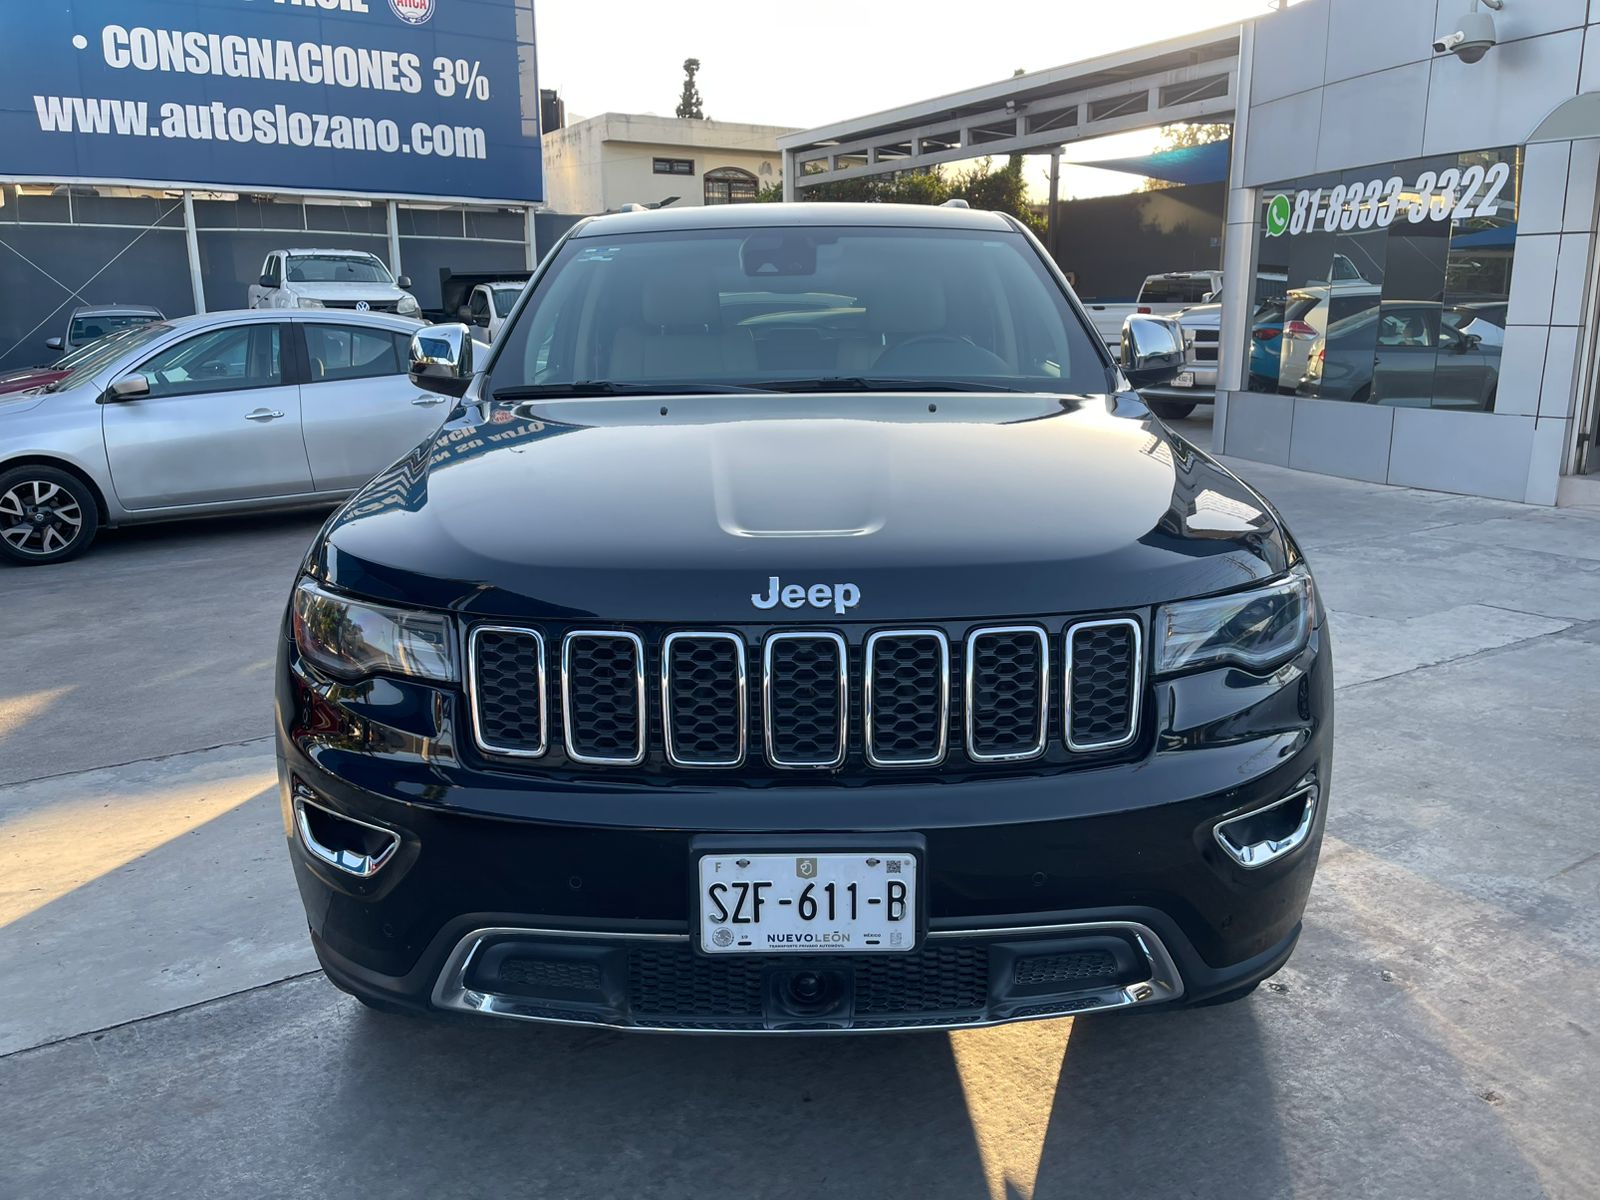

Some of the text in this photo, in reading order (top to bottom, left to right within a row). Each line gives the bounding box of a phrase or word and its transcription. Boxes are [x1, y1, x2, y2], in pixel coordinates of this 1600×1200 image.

[102, 24, 490, 101] CONSIGNACIONES 3%
[34, 95, 487, 159] www.autoslozano.com
[1289, 162, 1510, 236] 81-8333-3322
[751, 576, 861, 615] Jeep
[708, 880, 907, 924] SZF-611-B
